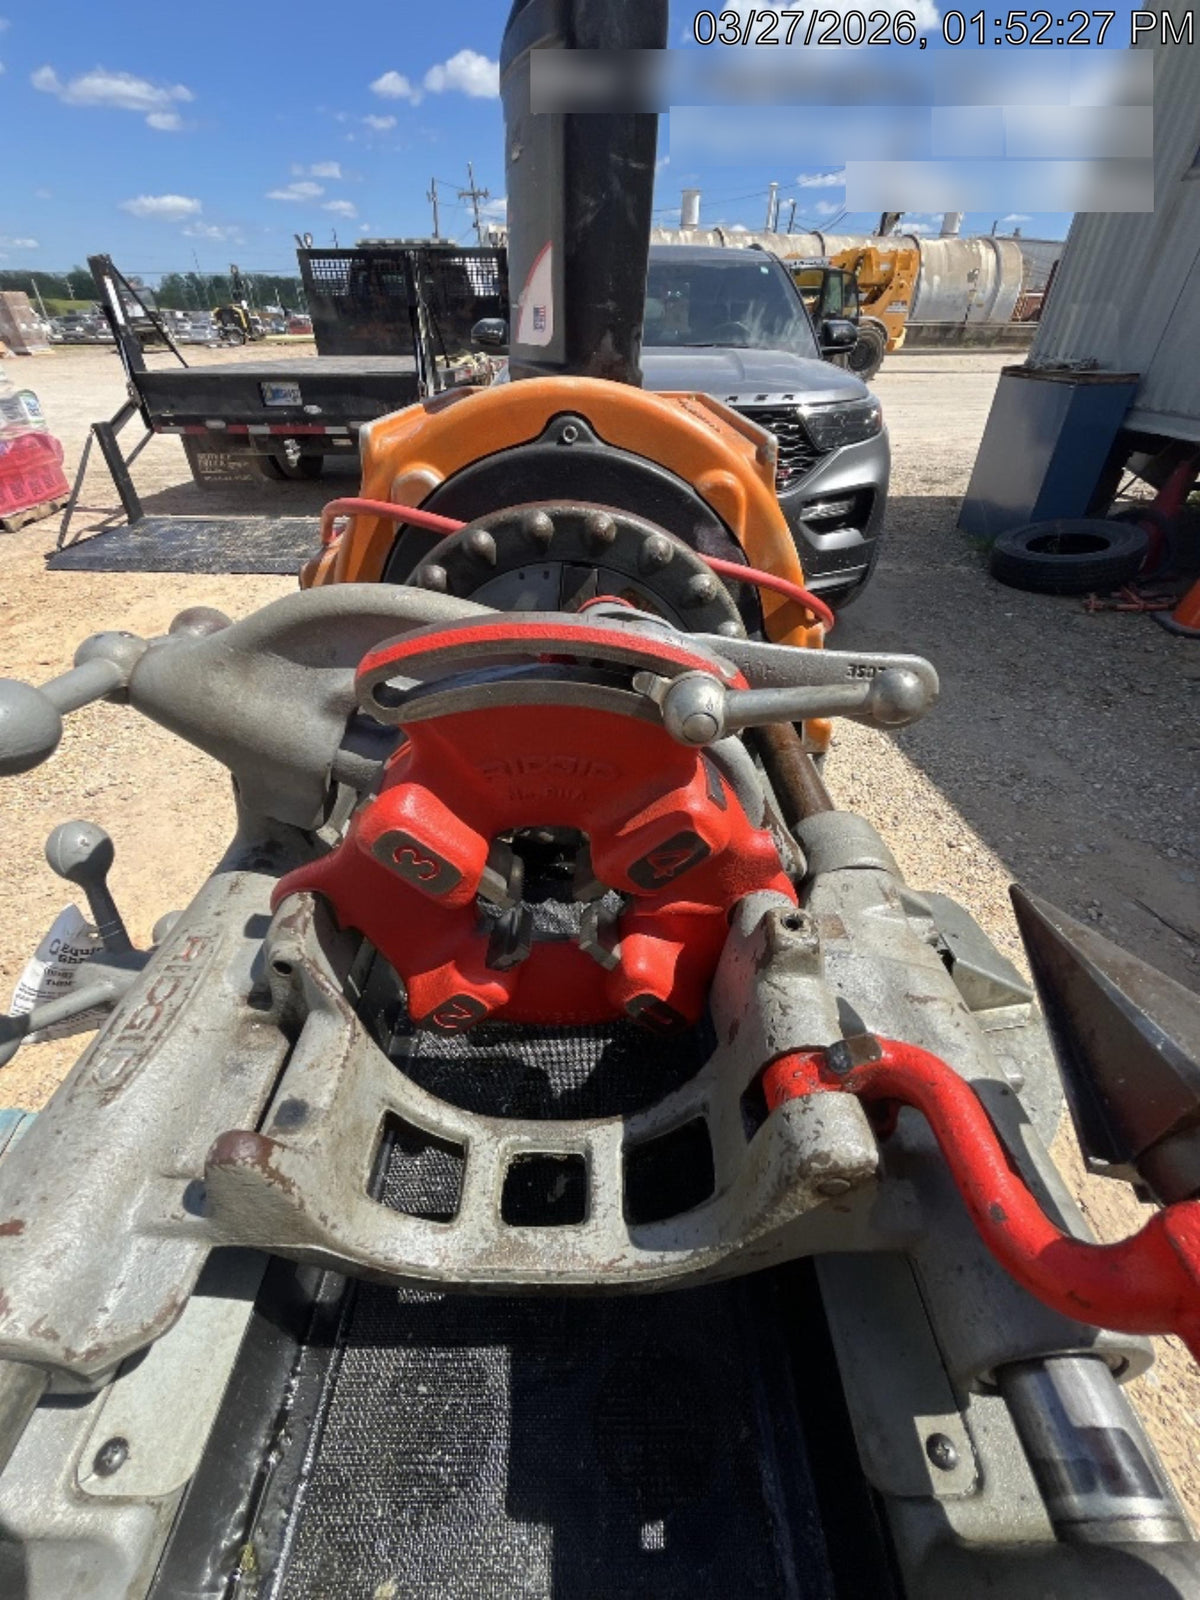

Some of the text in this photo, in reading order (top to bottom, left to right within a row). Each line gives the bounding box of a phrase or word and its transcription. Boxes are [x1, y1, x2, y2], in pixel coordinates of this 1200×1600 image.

[393, 843, 442, 881] 3
[647, 848, 696, 880] 4
[432, 1002, 474, 1029] 2
